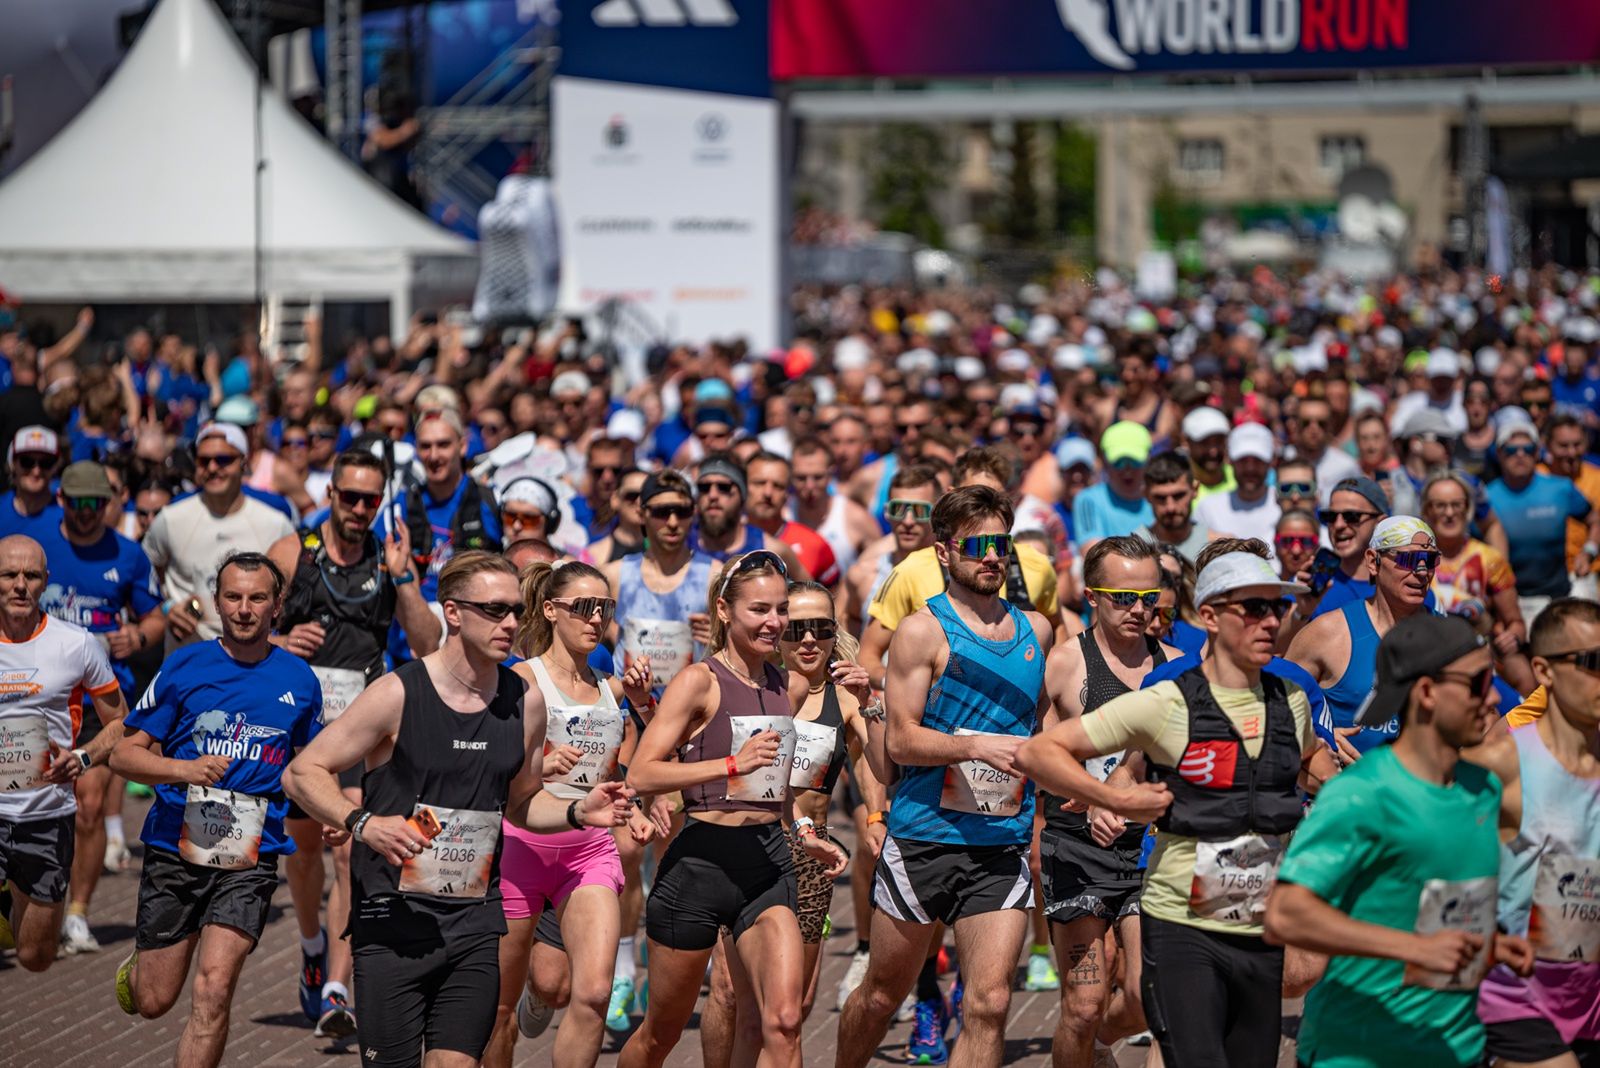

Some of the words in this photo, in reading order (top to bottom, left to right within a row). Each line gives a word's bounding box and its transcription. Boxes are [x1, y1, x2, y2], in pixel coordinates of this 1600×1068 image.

[971, 767, 1010, 784] 17284
[202, 821, 243, 841] 10663
[432, 846, 476, 863] 12036
[1220, 873, 1263, 890] 17565
